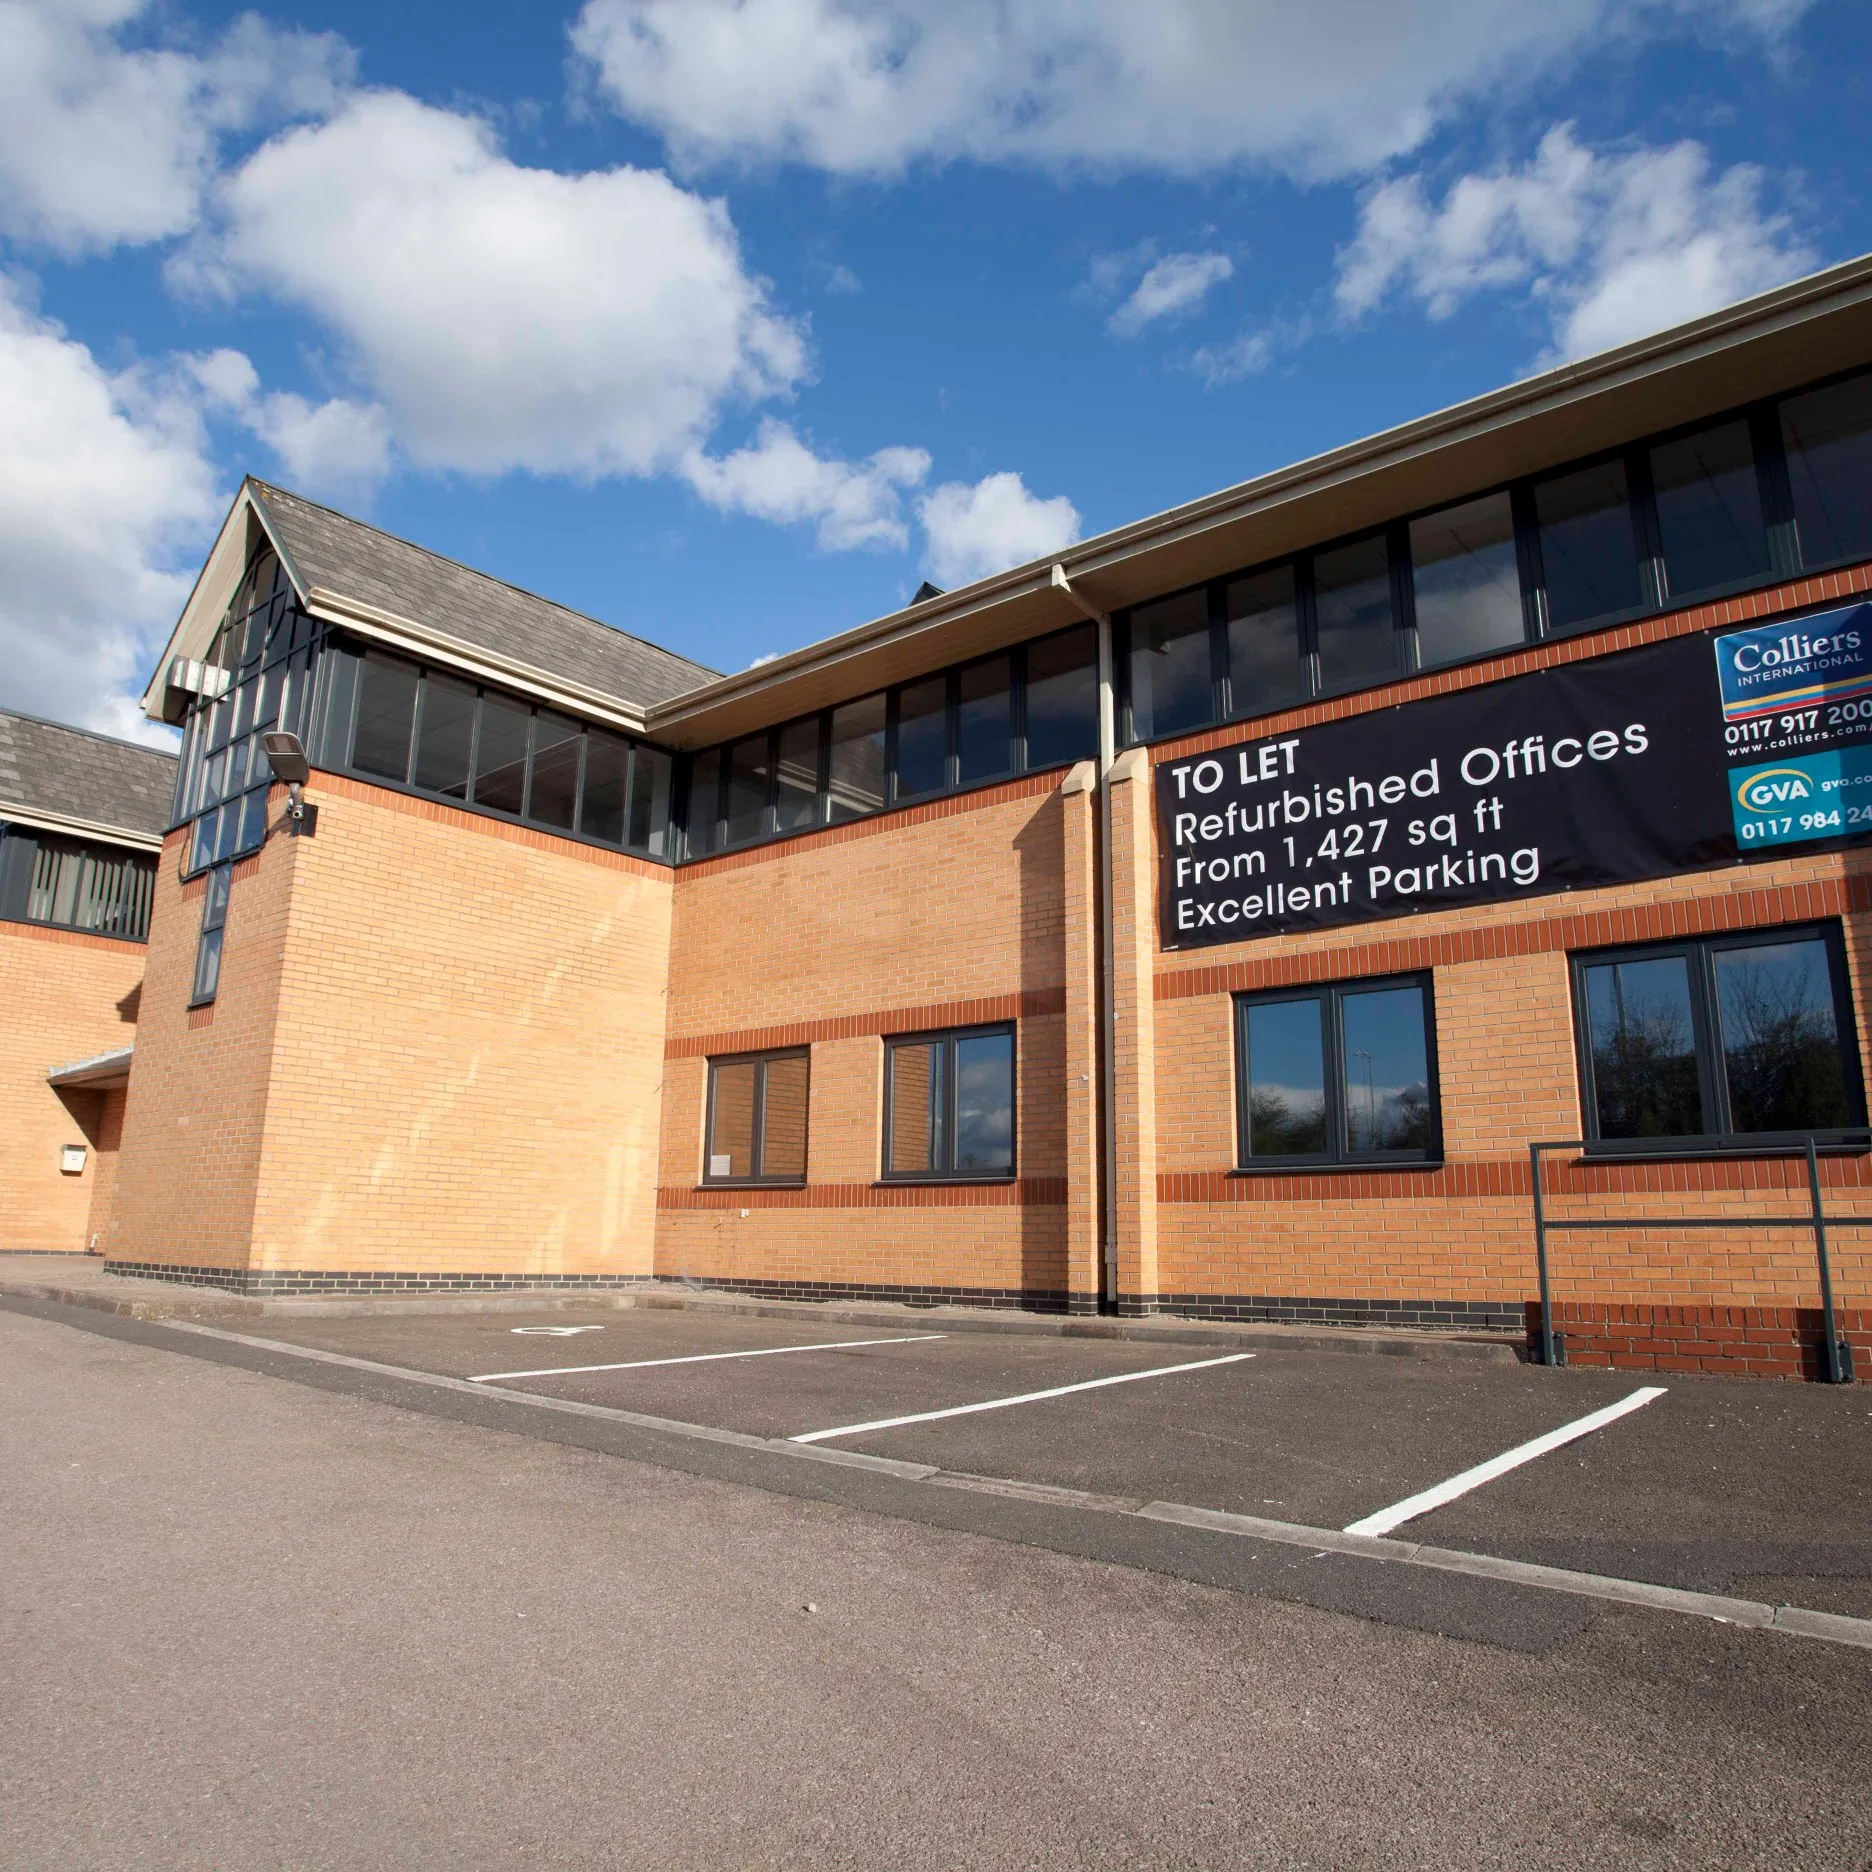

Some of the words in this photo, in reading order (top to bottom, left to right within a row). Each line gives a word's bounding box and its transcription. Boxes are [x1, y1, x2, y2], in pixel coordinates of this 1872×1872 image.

[1733, 631, 1861, 672] Colliers
[1737, 652, 1863, 687] INTERNATIONAL
[1724, 719, 1773, 744] 0117
[1780, 710, 1819, 734] 917
[1827, 700, 1872, 725] 200
[1172, 761, 1224, 799] TO
[1239, 739, 1300, 785] LET
[1175, 759, 1440, 845] Refurbished
[1460, 723, 1649, 786] Offices
[1751, 779, 1810, 805] GVA
[1176, 850, 1266, 888] From
[1283, 818, 1388, 868] 1,427
[1408, 813, 1457, 847] sq
[1473, 796, 1505, 833] ft
[1741, 817, 1792, 840] 0117
[1800, 810, 1841, 831] 984
[1178, 871, 1353, 930] Excellent
[1369, 847, 1540, 899] Parking
